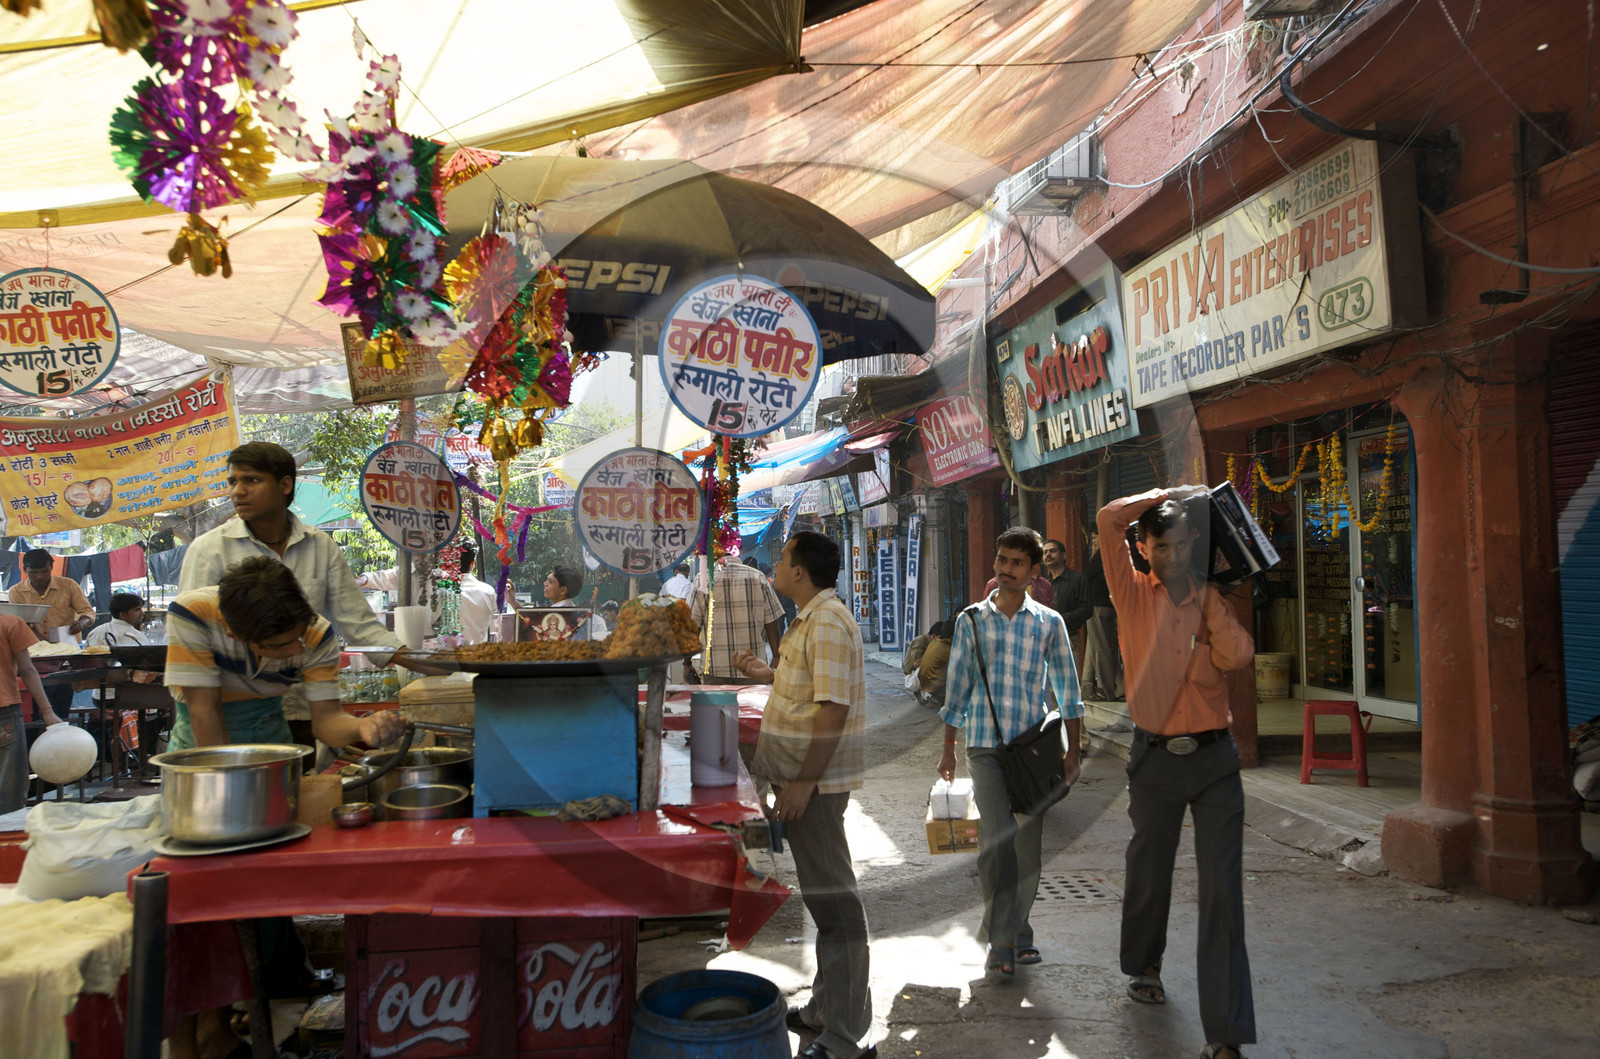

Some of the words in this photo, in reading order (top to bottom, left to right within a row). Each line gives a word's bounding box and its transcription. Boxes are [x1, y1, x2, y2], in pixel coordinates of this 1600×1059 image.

[26, 275, 56, 289] माता
[59, 276, 71, 289] दी
[558, 258, 671, 296] EPSI
[1132, 232, 1225, 347] PRIYA
[1229, 189, 1373, 306] ENTERPRISES
[691, 291, 730, 322] वेज
[714, 284, 736, 299] जय
[741, 284, 776, 307] माता
[774, 295, 793, 315] दी
[803, 280, 889, 321] PEPSI
[1323, 282, 1366, 326] 473
[48, 300, 113, 341] पनीर
[59, 342, 103, 367] रोटी
[668, 318, 740, 364] काठी
[743, 327, 814, 378] पनीर
[998, 345, 1008, 359] 474
[1137, 360, 1167, 395] TAPE
[1171, 330, 1246, 384] RECORDER
[1251, 304, 1311, 358] PARS
[37, 369, 72, 396] 15
[1025, 325, 1109, 413] Satkar
[186, 381, 218, 412] रोटी
[671, 362, 745, 401] रूमाली
[748, 371, 797, 409] रोटी
[707, 398, 744, 430] 15
[922, 396, 984, 455] SONUS
[1080, 388, 1128, 440] LINES
[10, 456, 34, 471] रोटी
[40, 458, 47, 468] 3
[376, 456, 399, 475] वेज
[934, 444, 969, 471] ELECTRONIC
[365, 471, 417, 506] काठी
[417, 473, 454, 510] रोल
[597, 466, 627, 486] वेज
[582, 481, 645, 520] काठी
[645, 481, 696, 521] रोल
[800, 505, 816, 514] PLAY
[371, 504, 420, 530] रूमाली
[422, 509, 451, 531] रोटी
[402, 527, 425, 550] 15
[588, 523, 646, 548] रूमाली
[650, 524, 688, 548] रोटी
[622, 546, 652, 571] 15
[905, 587, 916, 651] BAN
